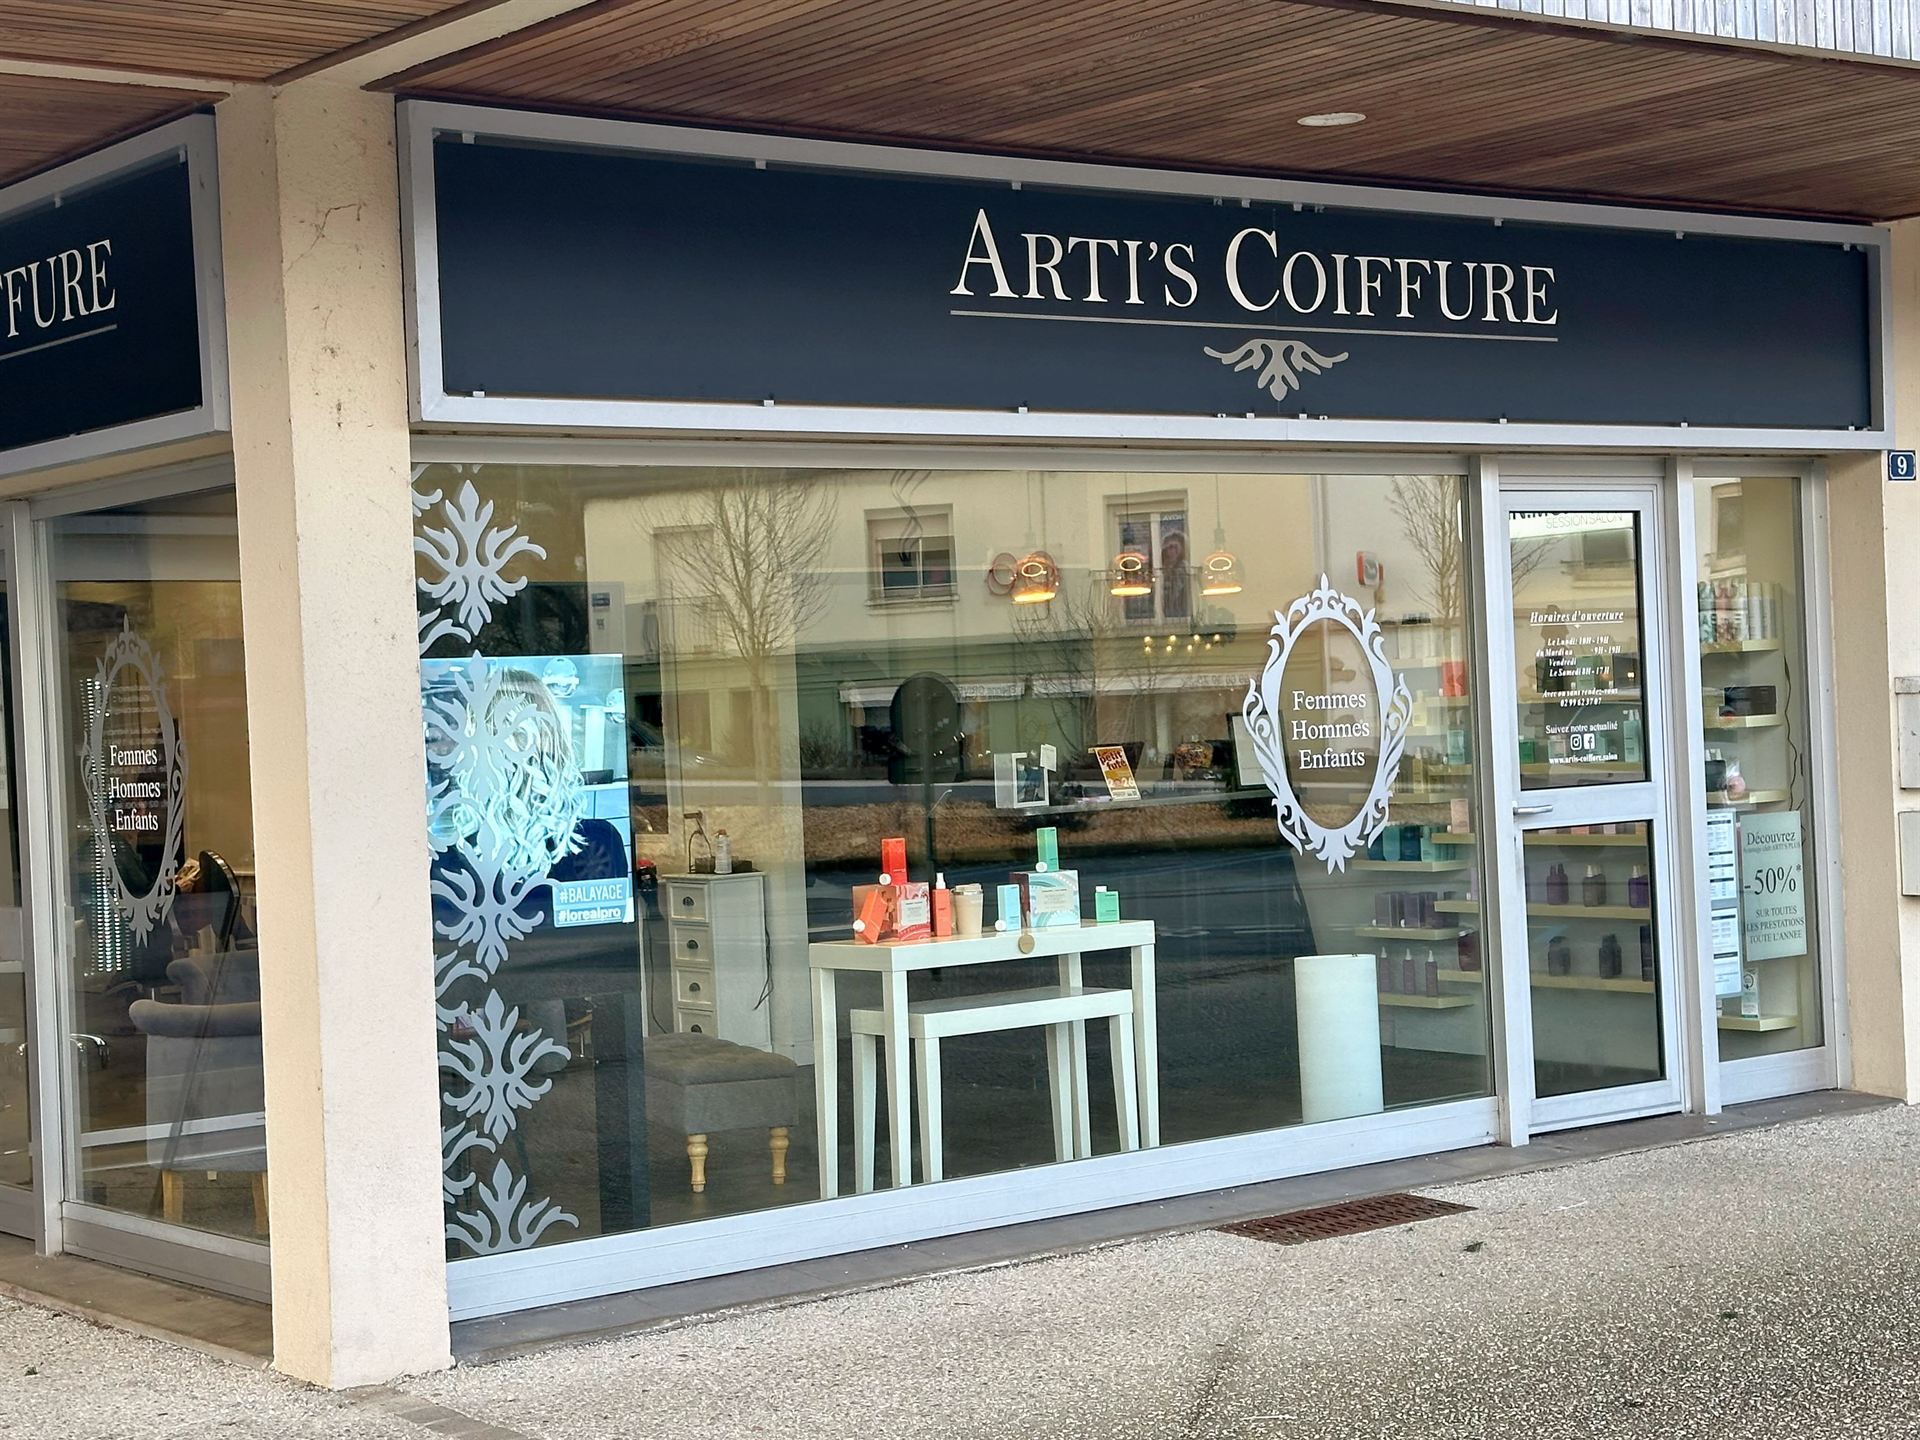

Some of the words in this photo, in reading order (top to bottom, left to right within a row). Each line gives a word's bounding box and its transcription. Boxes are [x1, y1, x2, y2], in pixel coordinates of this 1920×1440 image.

[949, 207, 1198, 308] ARTI'S
[1224, 227, 1559, 325] COIFFURE
[0, 239, 116, 338] FURE
[1897, 455, 1908, 475] 9
[1530, 611, 1570, 623] Horaires
[1571, 610, 1624, 621] d'ouverture
[1545, 648, 1564, 657] Mardi
[1549, 657, 1577, 667] Vendredi
[1292, 690, 1367, 711] Femmes
[1543, 690, 1557, 698] Avec
[1581, 688, 1618, 696] rendez-vous
[1291, 720, 1370, 741] Hommes
[1545, 724, 1569, 735] Suivez
[1570, 724, 1588, 732] notre
[1589, 720, 1618, 731] actualité
[109, 744, 158, 766] Femmes
[1299, 747, 1366, 770] Enfants
[109, 777, 161, 799] Hommes
[115, 808, 159, 831] Enfants
[1747, 831, 1796, 846] Découvrez
[560, 884, 624, 903] #BALAYAGE
[558, 906, 621, 922] #lorealpro
[1755, 908, 1770, 918] SUR
[1770, 905, 1798, 917] TOUTES
[1746, 922, 1760, 932] LES
[1760, 916, 1805, 931] PRESTATIONS
[1750, 933, 1772, 944] TOUTE
